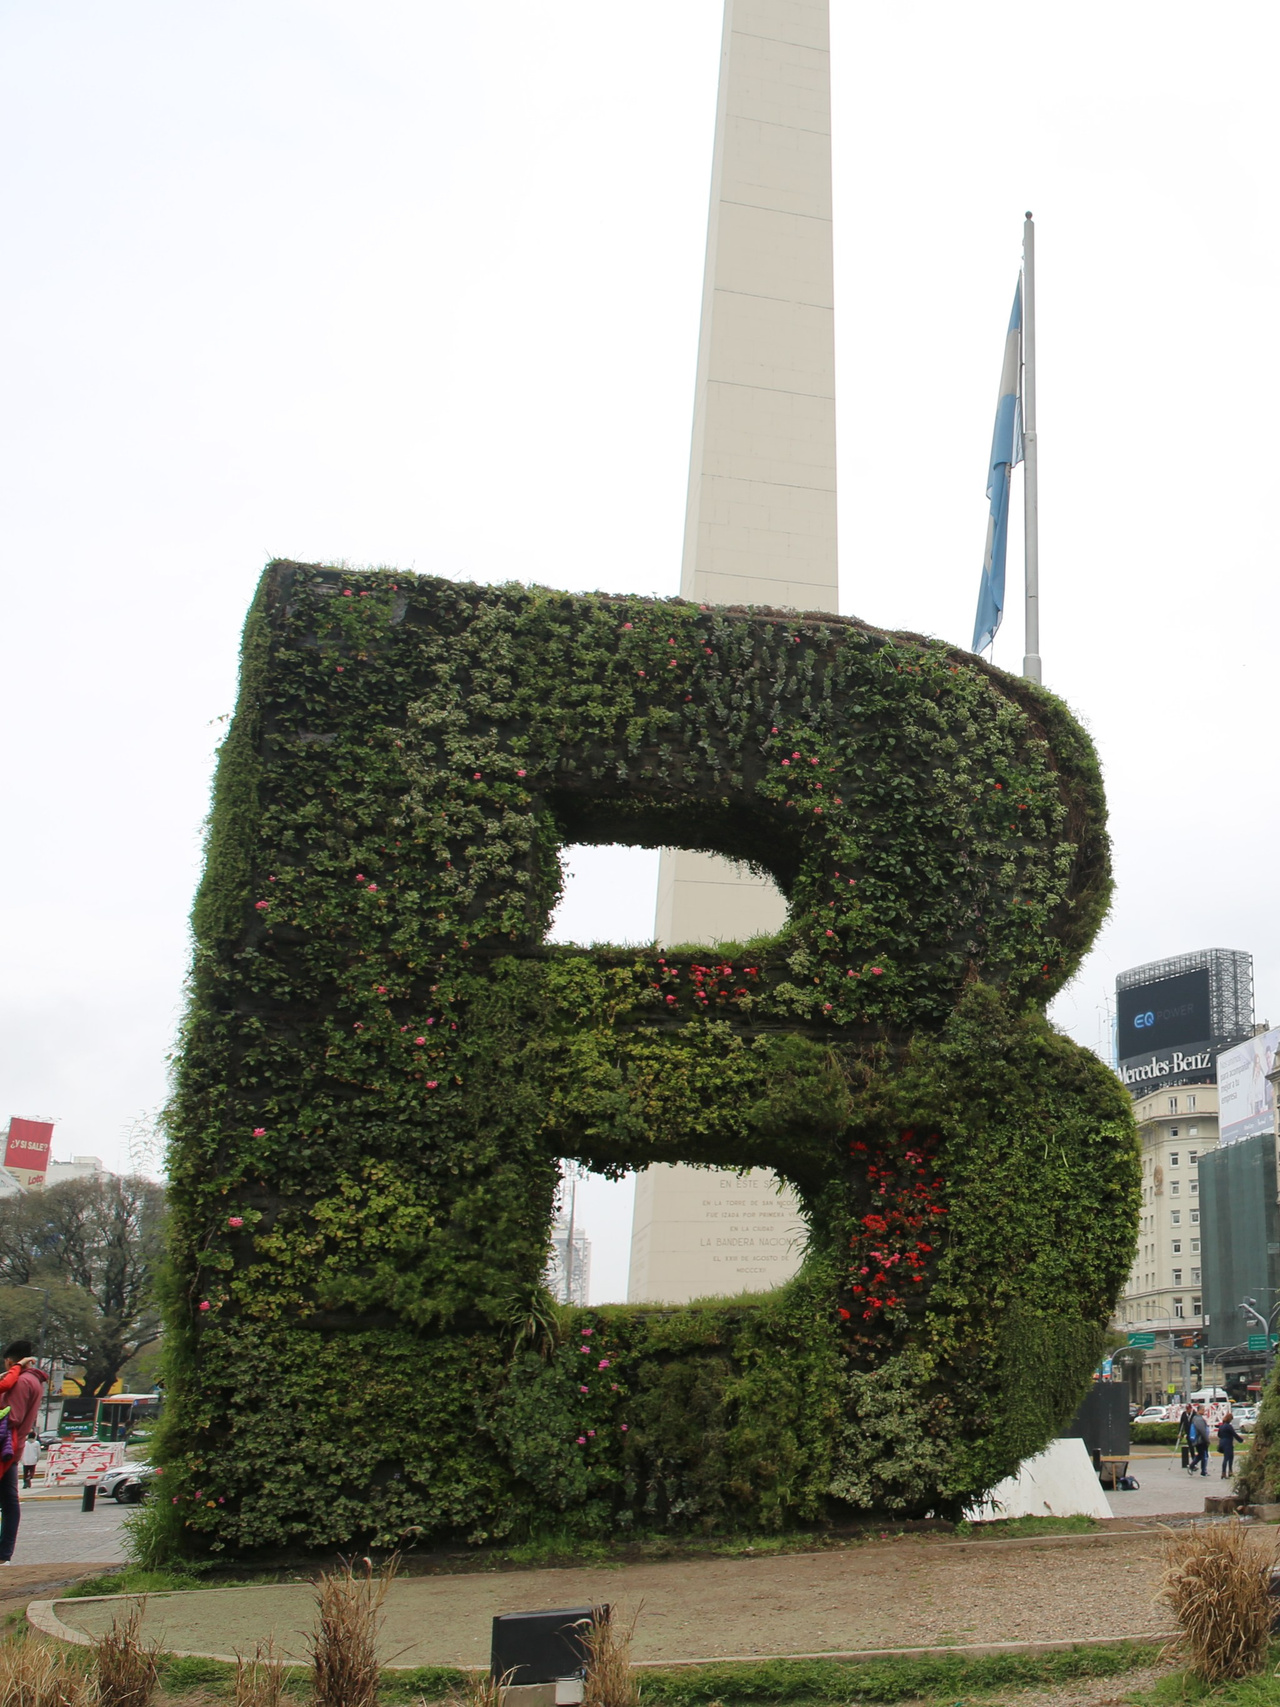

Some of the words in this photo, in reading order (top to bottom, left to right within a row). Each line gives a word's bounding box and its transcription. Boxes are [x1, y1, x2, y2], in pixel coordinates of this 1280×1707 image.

[1133, 1011, 1155, 1029] EQ
[1117, 1052, 1212, 1085] Mercedes-Benz
[20, 1140, 27, 1149] SI
[27, 1141, 49, 1152] SALE?
[28, 1175, 44, 1185] Loto
[720, 1179, 731, 1188] EN
[736, 1179, 758, 1188] ESTE
[700, 1237, 711, 1246] LA
[716, 1237, 755, 1246] BANDERA
